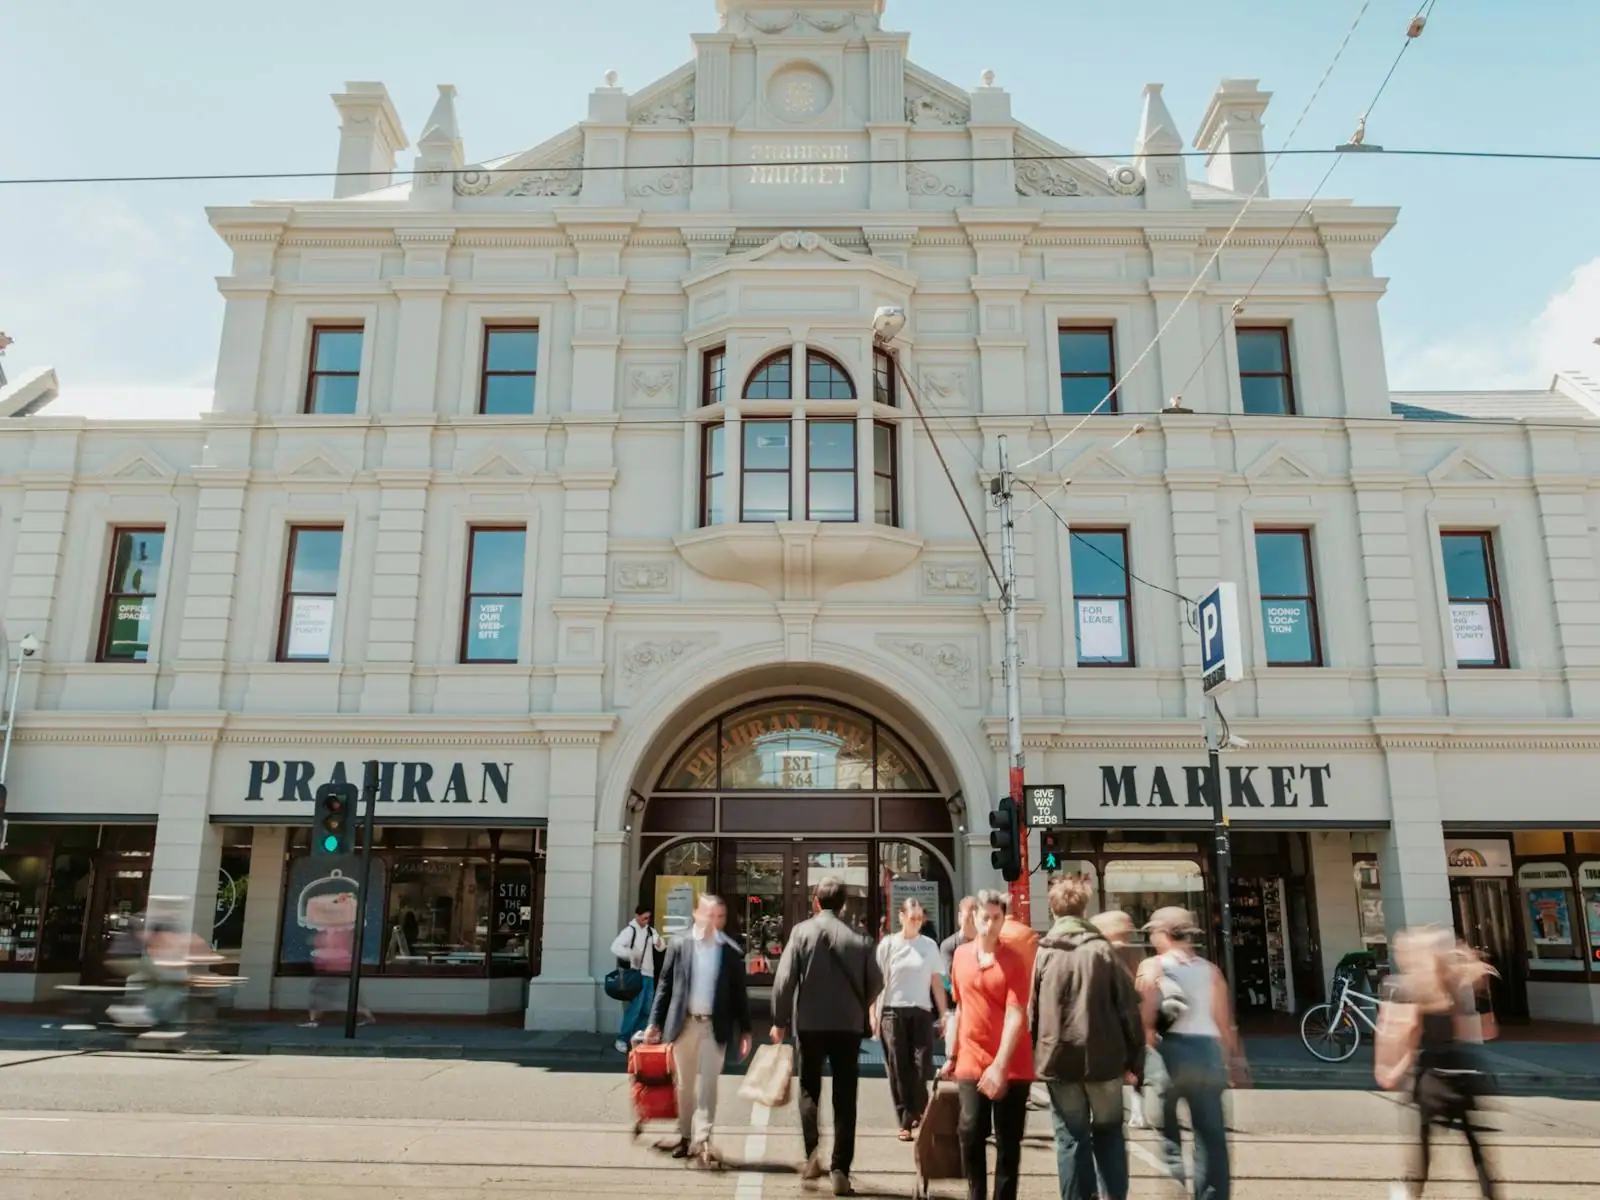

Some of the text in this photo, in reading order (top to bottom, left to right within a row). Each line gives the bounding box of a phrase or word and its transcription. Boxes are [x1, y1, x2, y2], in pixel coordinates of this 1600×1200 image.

[749, 165, 849, 184] MARKET
[480, 604, 504, 612] VISIT
[1083, 606, 1102, 614] FOR
[1267, 608, 1300, 616] ICONIC
[479, 613, 500, 621] OUR
[1083, 615, 1113, 623] LEASE
[1268, 616, 1299, 625] LOCA-
[1202, 602, 1218, 661] P
[1269, 625, 1292, 633] TION
[478, 630, 500, 639] SITE
[782, 756, 812, 771] EST
[244, 760, 514, 803] PRAHRAN
[1098, 763, 1331, 807] MARKET
[1034, 789, 1054, 798] GIVE
[1034, 798, 1054, 807] WAY
[1037, 807, 1050, 816] TO
[1032, 816, 1058, 825] PEDS
[500, 883, 527, 897] STIR
[505, 899, 521, 909] THE
